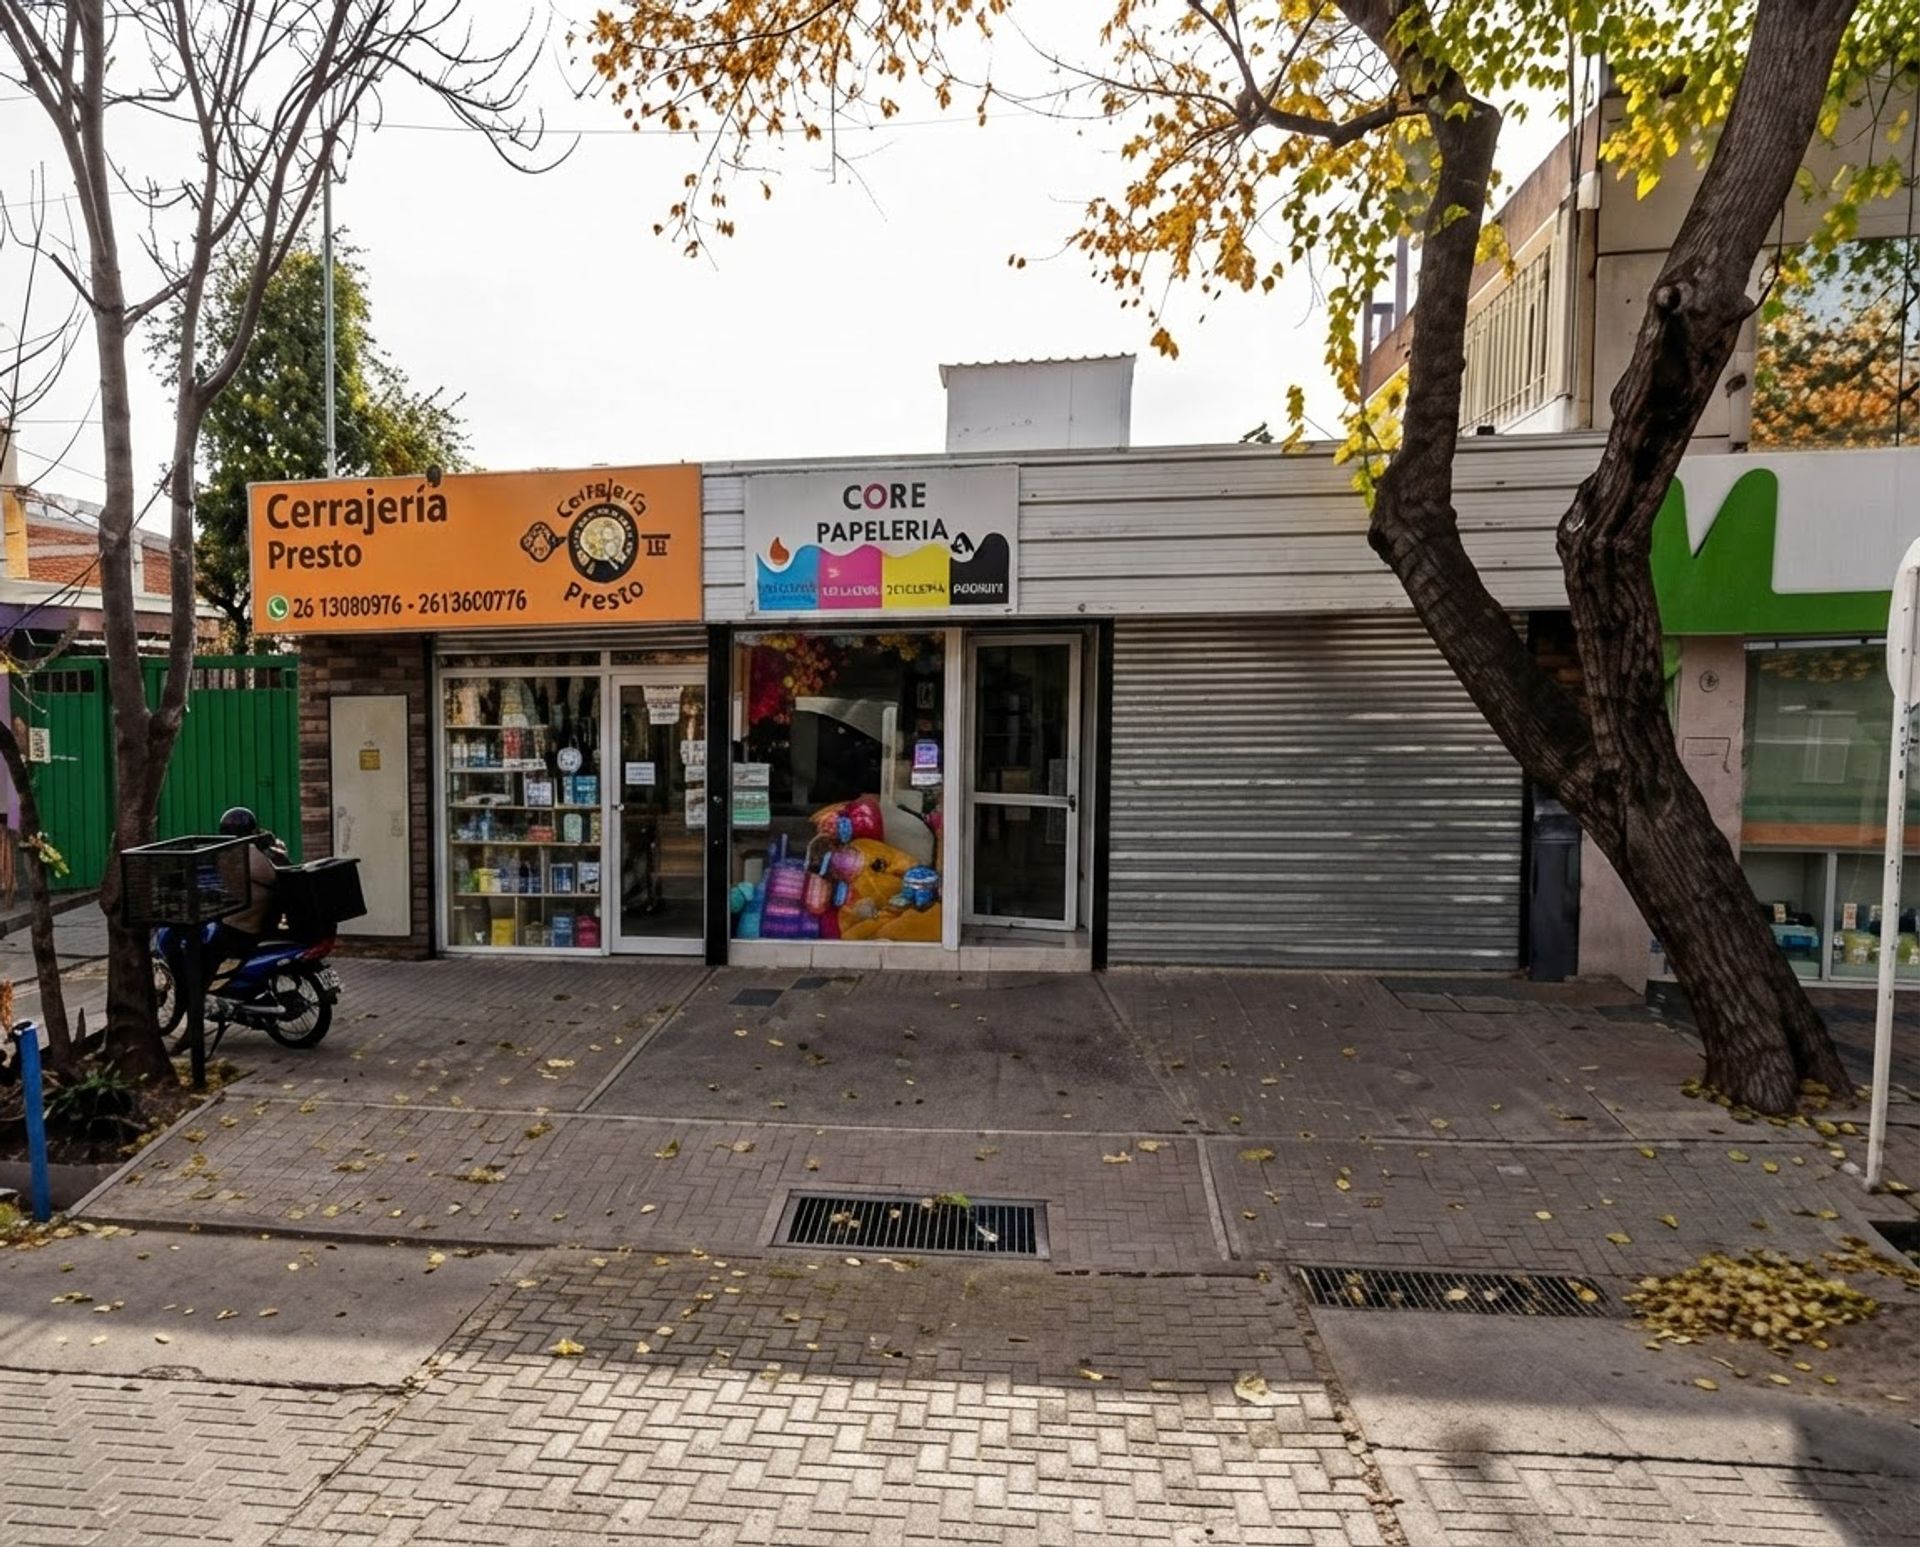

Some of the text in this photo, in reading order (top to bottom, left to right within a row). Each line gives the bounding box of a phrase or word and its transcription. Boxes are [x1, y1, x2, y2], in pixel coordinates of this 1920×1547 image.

[267, 484, 447, 535] Cerrajería
[843, 483, 926, 510] CORE
[817, 518, 949, 543] PAPELERIA
[268, 540, 362, 569] Presto
[293, 598, 314, 618] 26
[564, 581, 643, 610] Presto
